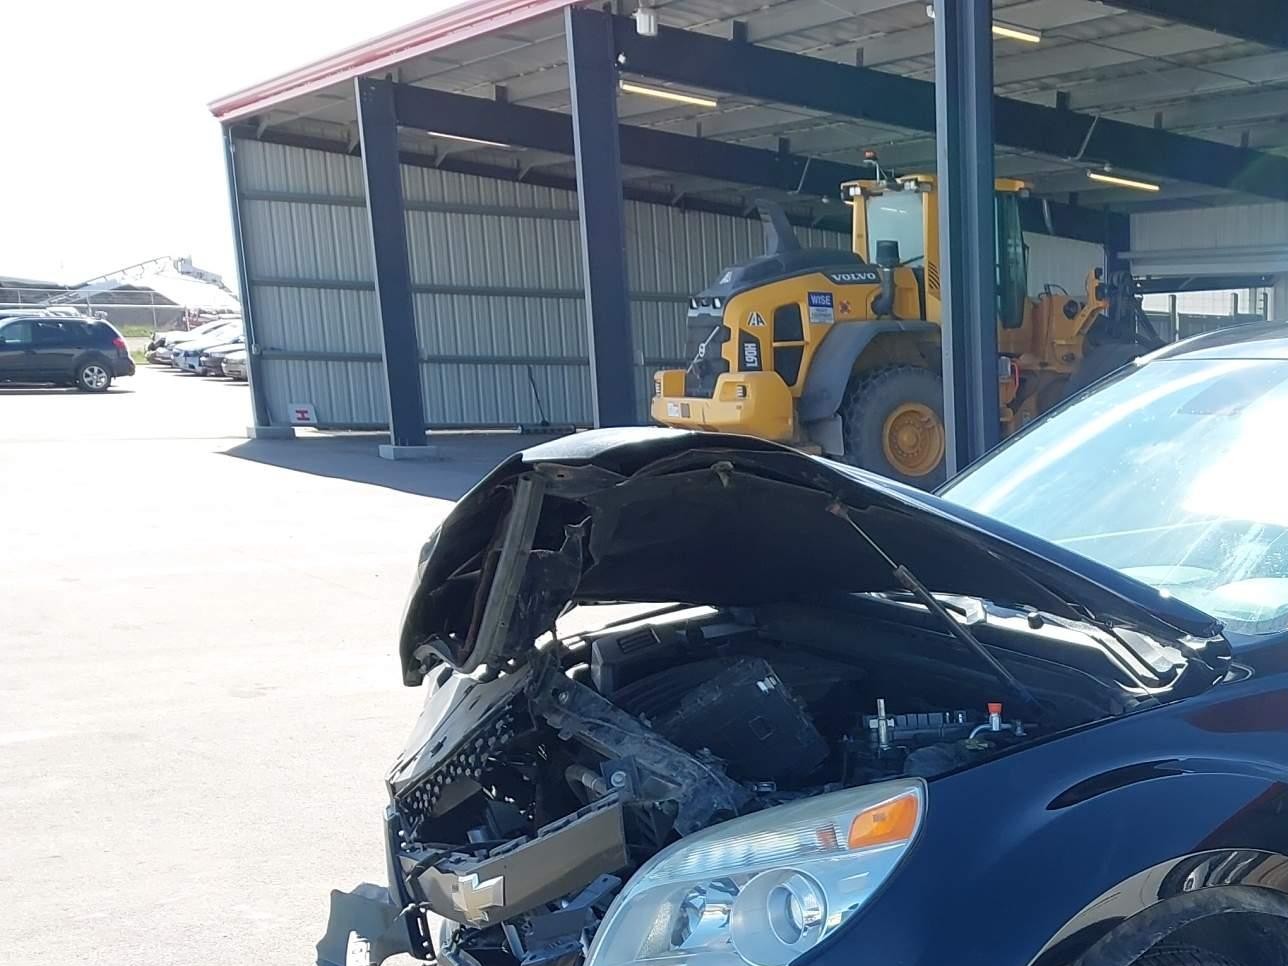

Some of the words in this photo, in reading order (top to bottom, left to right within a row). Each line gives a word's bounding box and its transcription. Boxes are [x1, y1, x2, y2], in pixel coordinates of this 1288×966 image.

[831, 271, 876, 281] VOLVO
[810, 294, 832, 305] WISE
[744, 343, 759, 367] L90H
